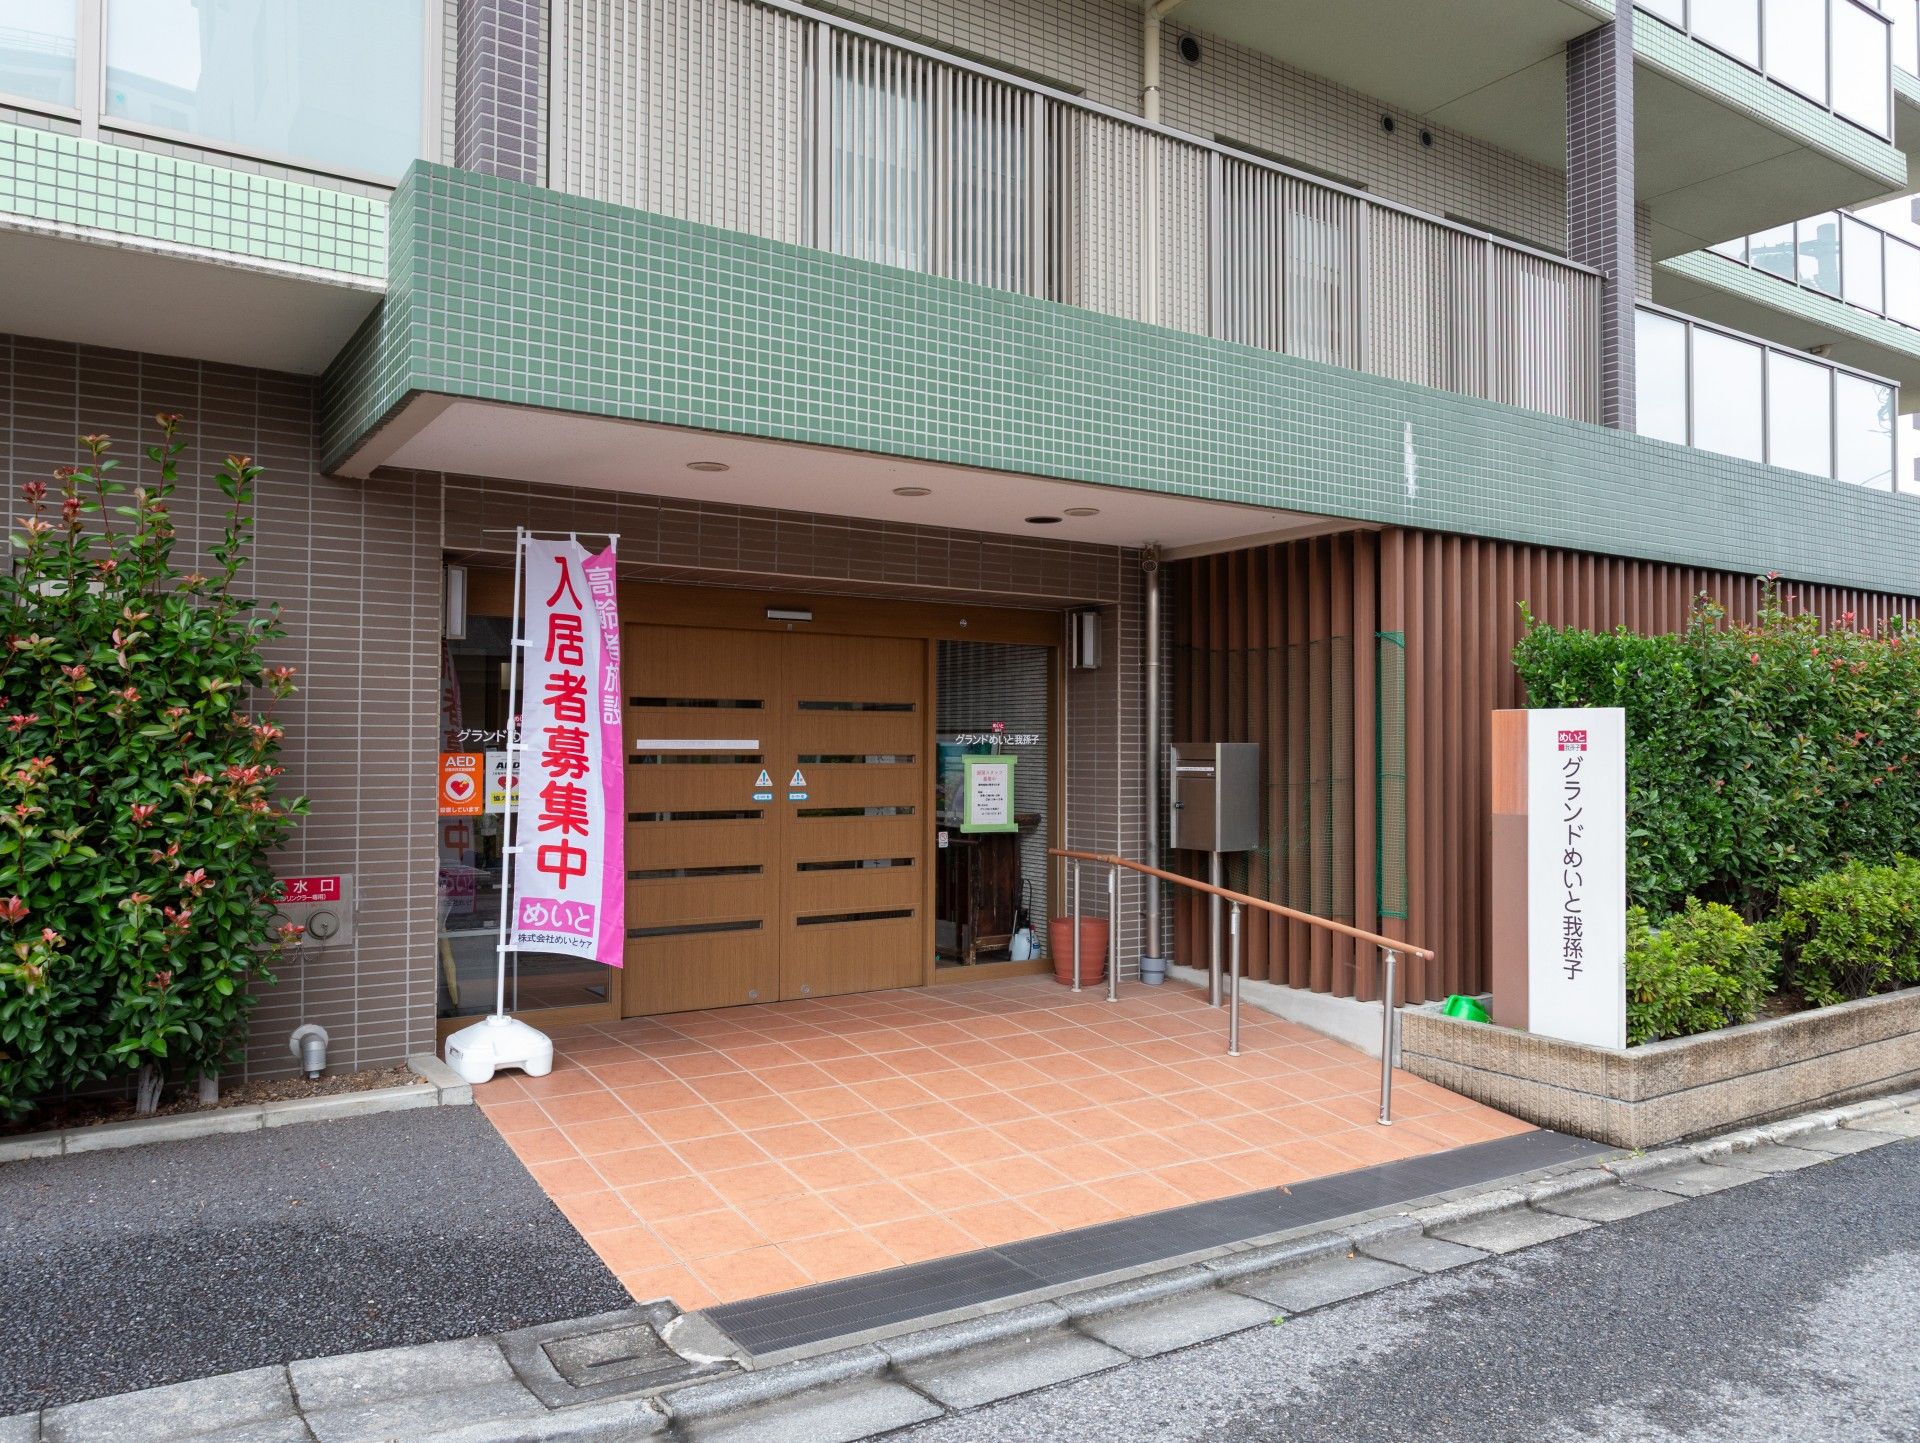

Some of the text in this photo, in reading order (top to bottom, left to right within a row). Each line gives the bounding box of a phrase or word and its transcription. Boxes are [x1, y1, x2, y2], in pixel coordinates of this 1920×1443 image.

[536, 555, 590, 890] 入居者募集中
[955, 733, 1040, 745] グランドめいと我孫子
[1559, 732, 1585, 742] めいと
[445, 756, 476, 767] AED
[1562, 756, 1585, 980] グランドめいと我孫子
[522, 902, 591, 932] めいと
[517, 933, 593, 949] 株式会社めいとケア
